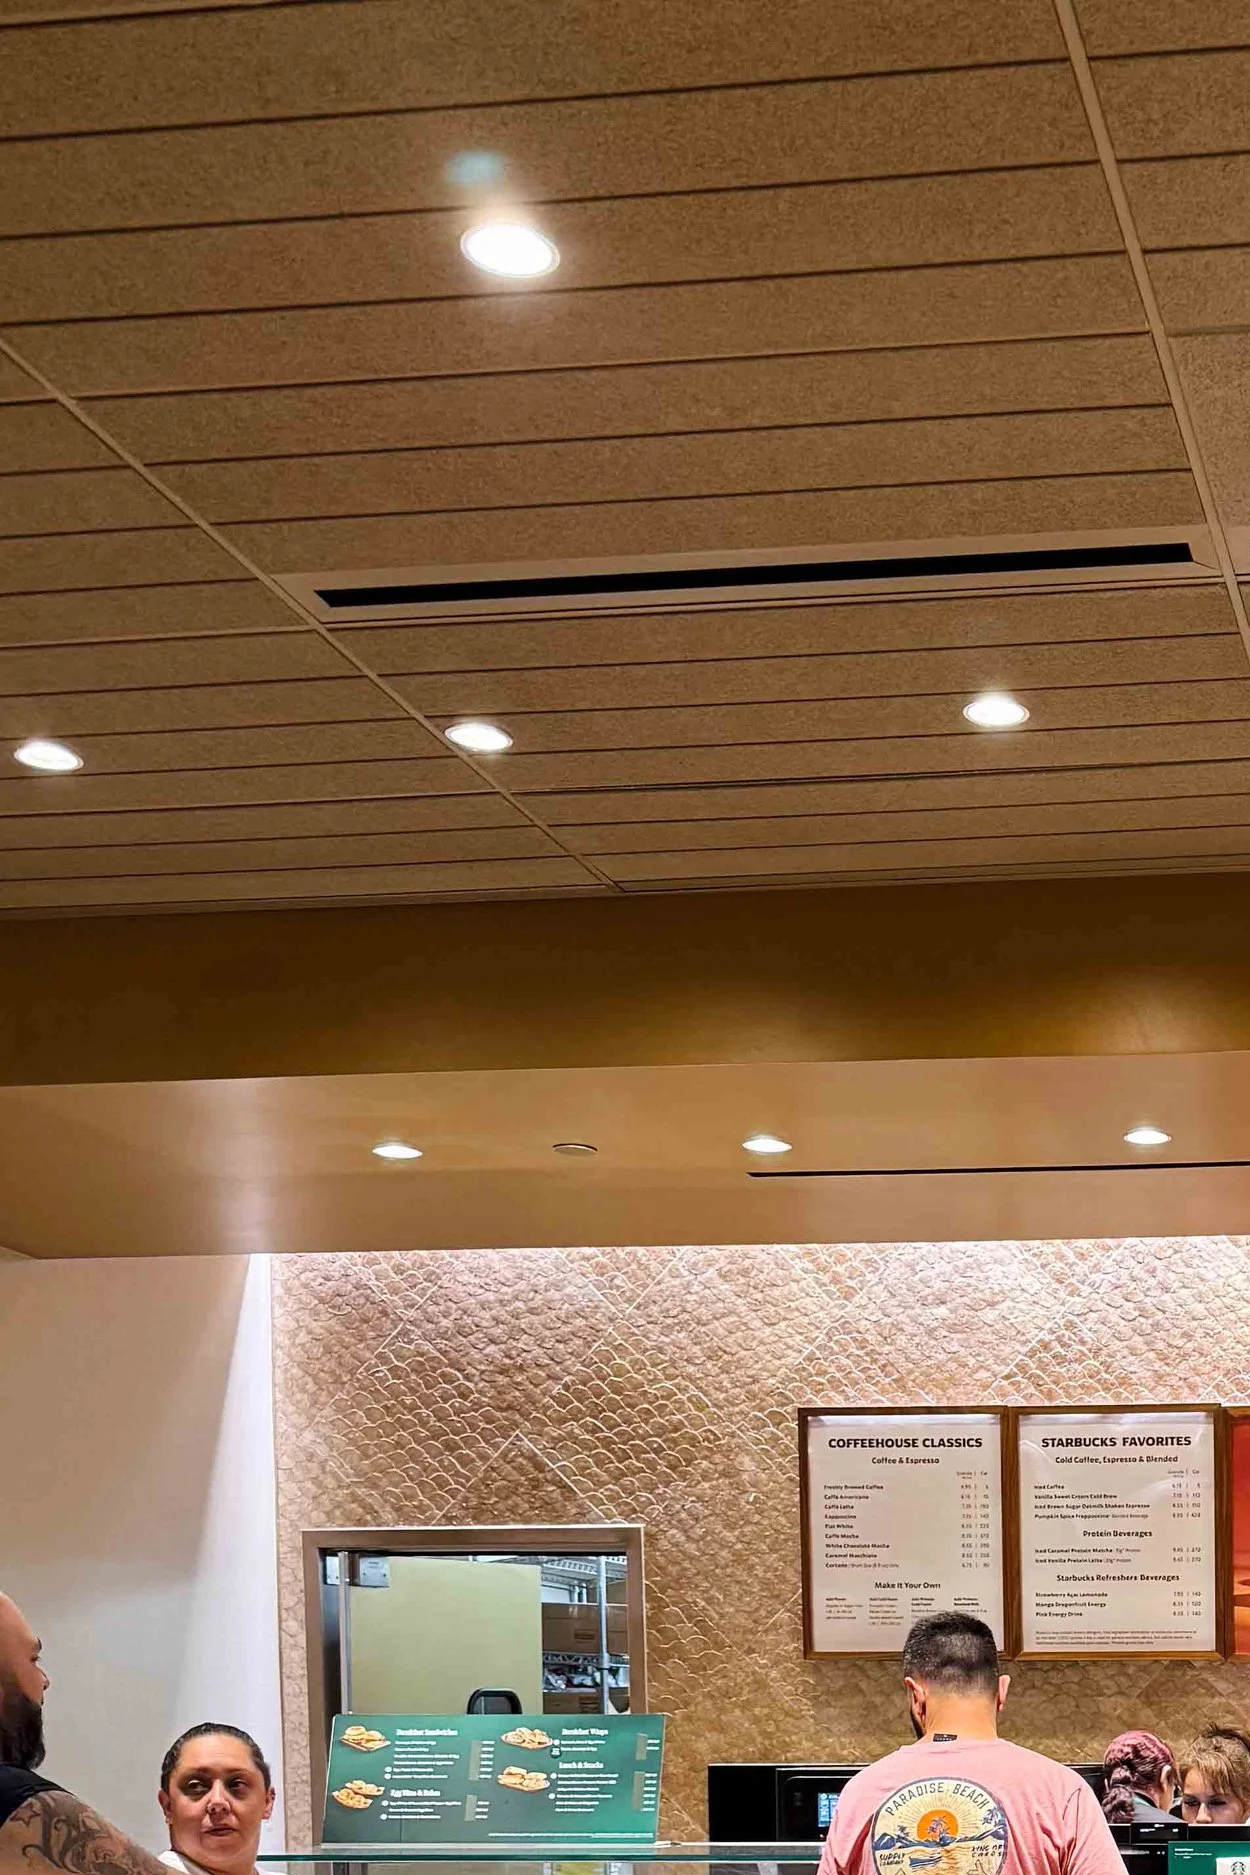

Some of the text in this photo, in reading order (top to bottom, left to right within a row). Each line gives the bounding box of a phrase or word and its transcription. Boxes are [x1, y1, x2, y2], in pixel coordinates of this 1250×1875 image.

[828, 1438, 983, 1448] COFFEEHOUSE CLASSICS
[1042, 1437, 1191, 1447] STARBUCKS FAVORITES
[905, 1457, 940, 1465] Espresso
[1074, 1457, 1101, 1465] Coffee,
[1113, 1530, 1152, 1538] Beverages
[1057, 1574, 1094, 1582] Starbucks
[1140, 1574, 1180, 1582] Beverages
[885, 1782, 989, 1816] PARADISE BEACH
